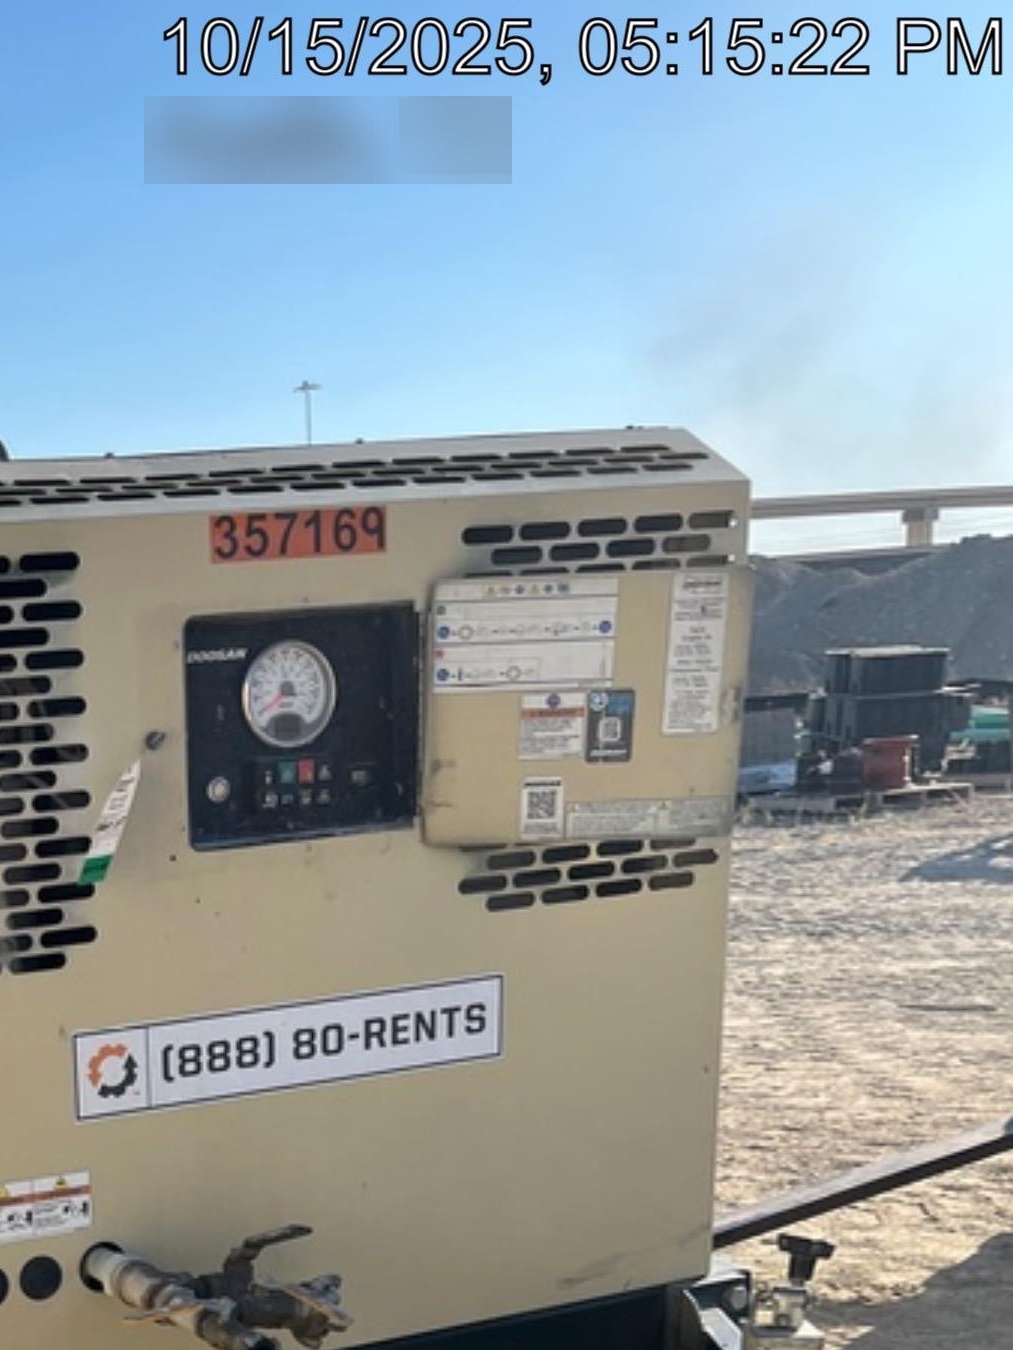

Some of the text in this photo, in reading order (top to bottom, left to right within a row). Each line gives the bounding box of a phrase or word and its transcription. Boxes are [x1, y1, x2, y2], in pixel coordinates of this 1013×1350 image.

[212, 506, 386, 561] 357169
[162, 1003, 487, 1083] (888) 80-RENTS
